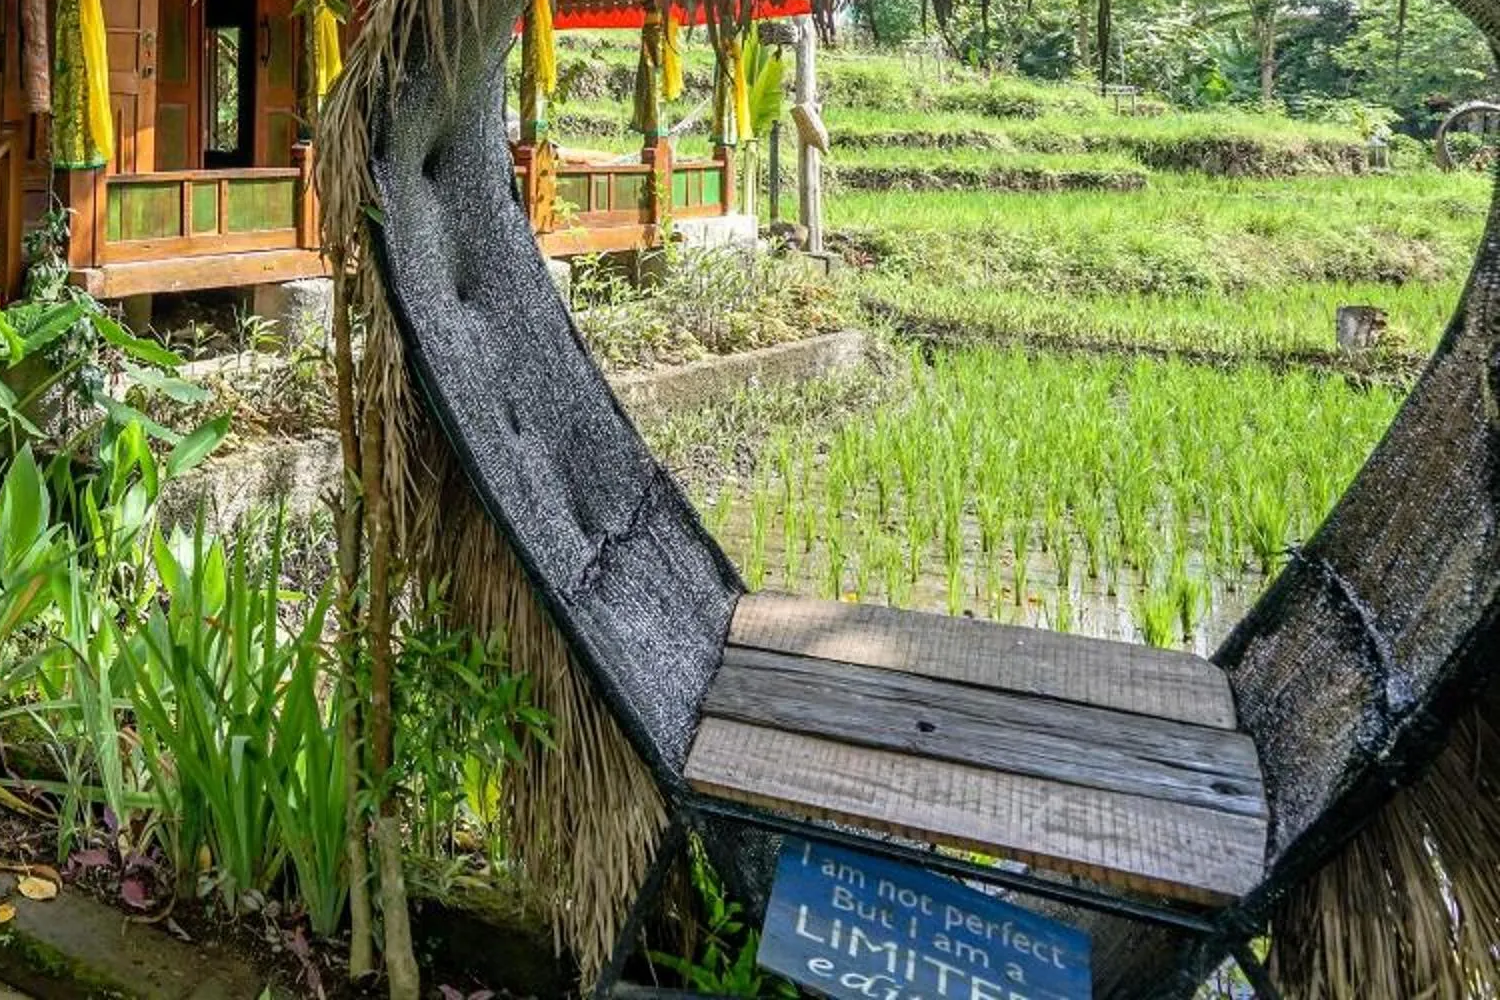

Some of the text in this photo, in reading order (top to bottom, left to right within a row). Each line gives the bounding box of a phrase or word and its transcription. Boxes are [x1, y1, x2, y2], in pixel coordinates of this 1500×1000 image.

[796, 904, 1030, 1000] LIMITE
[802, 842, 1067, 970] I am not perfect
[832, 885, 1027, 985] But I am a
